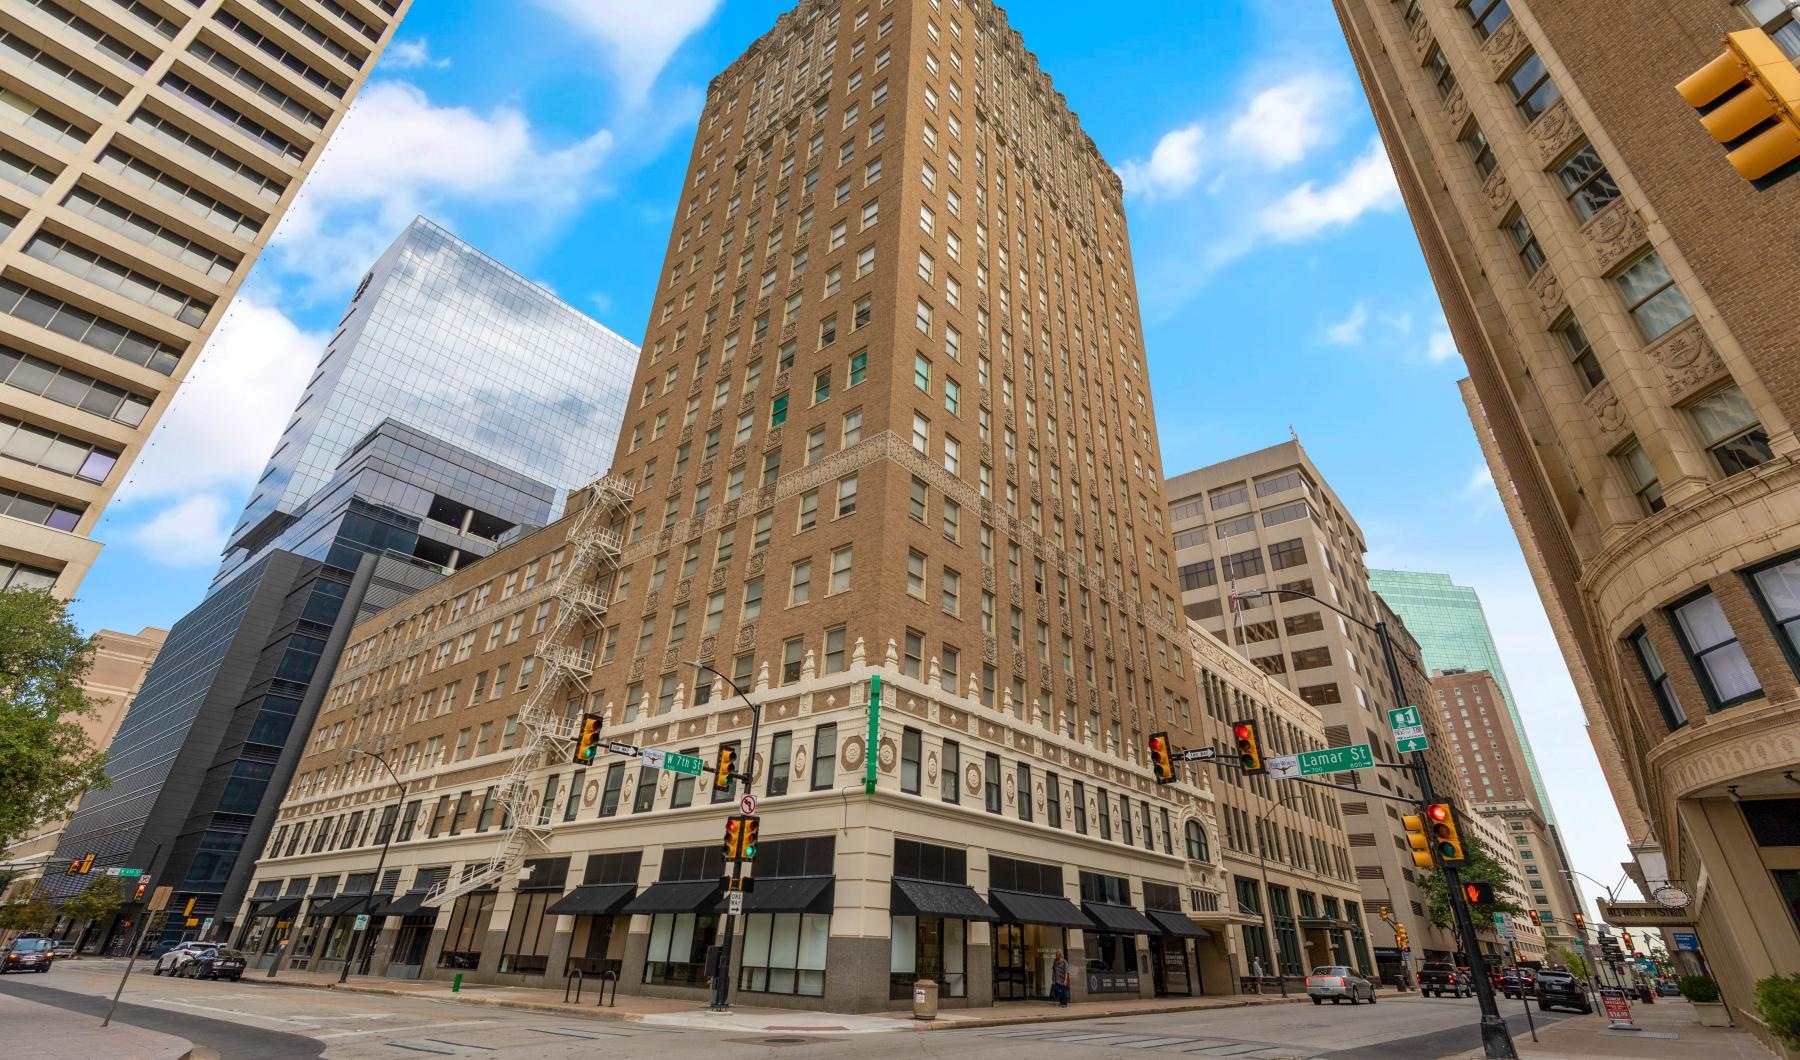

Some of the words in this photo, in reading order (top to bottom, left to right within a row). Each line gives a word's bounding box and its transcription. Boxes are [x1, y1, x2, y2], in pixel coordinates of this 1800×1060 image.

[667, 754, 673, 764] W
[677, 756, 689, 768] 7th
[692, 759, 701, 770] St
[1302, 752, 1343, 767] Lamar
[1350, 747, 1367, 761] St
